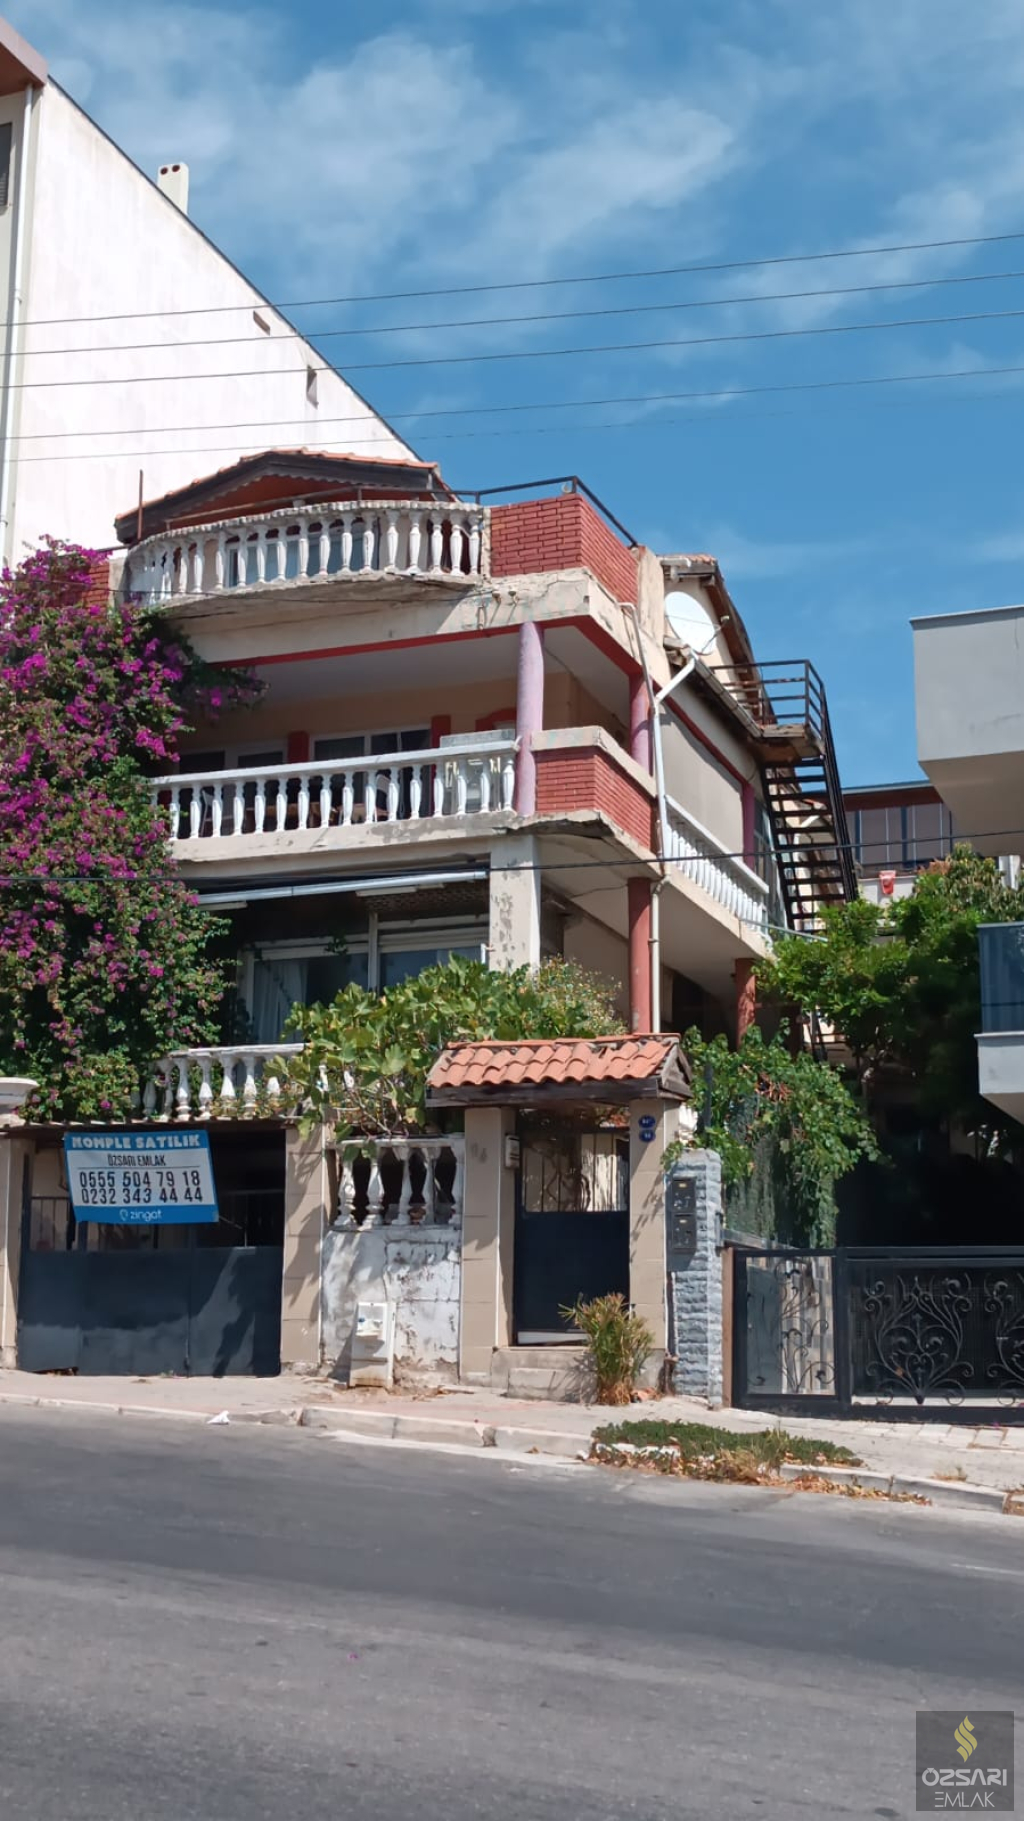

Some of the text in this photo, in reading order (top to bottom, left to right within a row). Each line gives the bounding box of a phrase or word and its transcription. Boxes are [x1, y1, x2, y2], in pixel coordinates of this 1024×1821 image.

[72, 1134, 200, 1149] KOMPLE SATILIK
[137, 1154, 166, 1166] EMLAK
[79, 1170, 201, 1188] 0555 504 79 18
[81, 1187, 203, 1204] 0232 343 44 44
[130, 1209, 162, 1222] zingat
